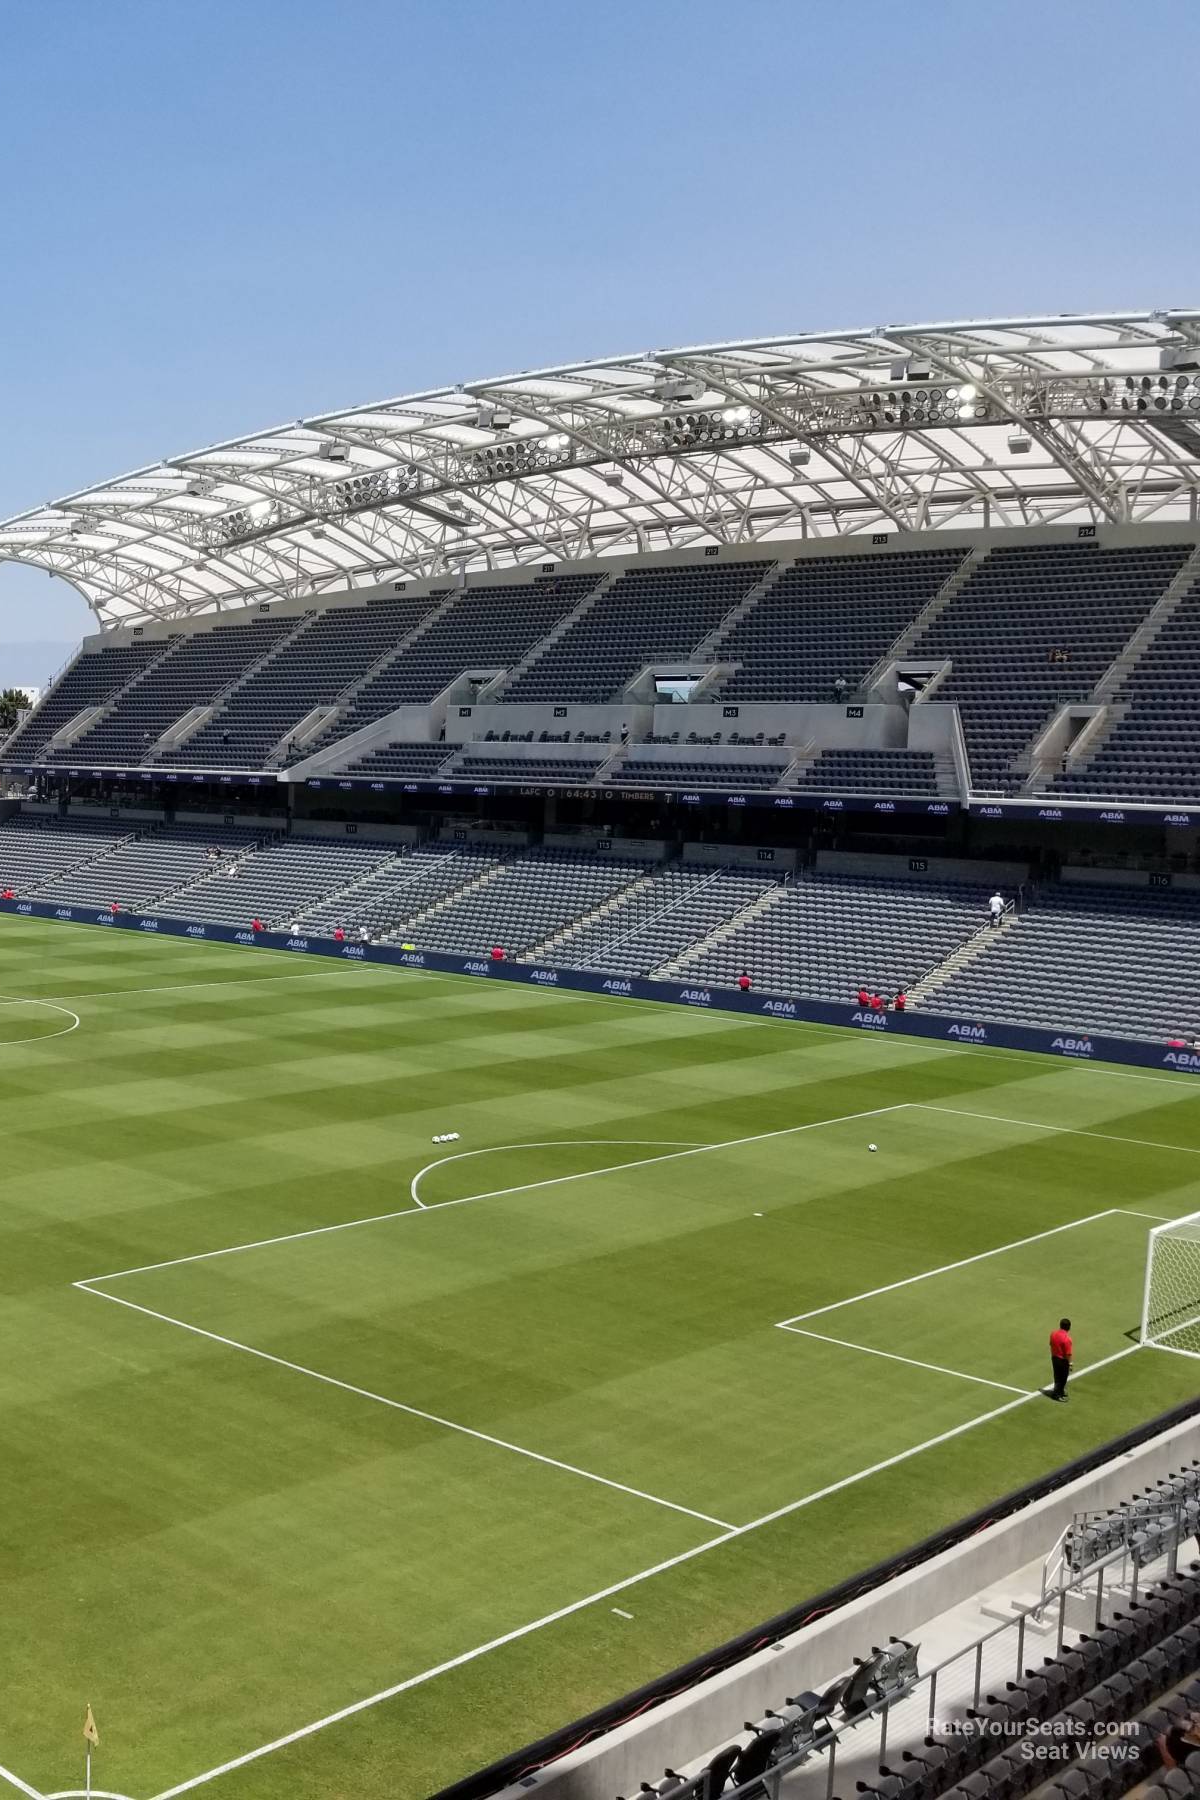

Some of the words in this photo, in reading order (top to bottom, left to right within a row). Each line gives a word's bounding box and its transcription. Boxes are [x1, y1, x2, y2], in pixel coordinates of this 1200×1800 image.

[725, 709, 736, 717] M3
[848, 709, 861, 717] M4
[621, 791, 655, 801] TIMBERS
[1099, 812, 1125, 820] ABM
[1163, 815, 1190, 823] ABM
[759, 851, 772, 860] 114
[911, 861, 925, 870] 115
[1153, 876, 1168, 885] 116
[16, 902, 32, 911] ABM
[55, 908, 72, 916] ABM
[96, 914, 114, 922] ABM
[139, 919, 158, 928] ABM
[185, 925, 206, 934] ABM
[234, 932, 255, 941] ABM
[286, 938, 308, 948] ABM
[341, 946, 364, 955] ABM
[400, 953, 425, 963] ABM
[464, 962, 490, 972] ABM
[531, 971, 559, 981] ABM
[603, 980, 632, 991] ABM
[680, 990, 712, 1001] ABM
[763, 1001, 796, 1012] ABM
[852, 1013, 887, 1024] ABM
[948, 1025, 986, 1037] ABM
[1051, 1038, 1094, 1051] ABM
